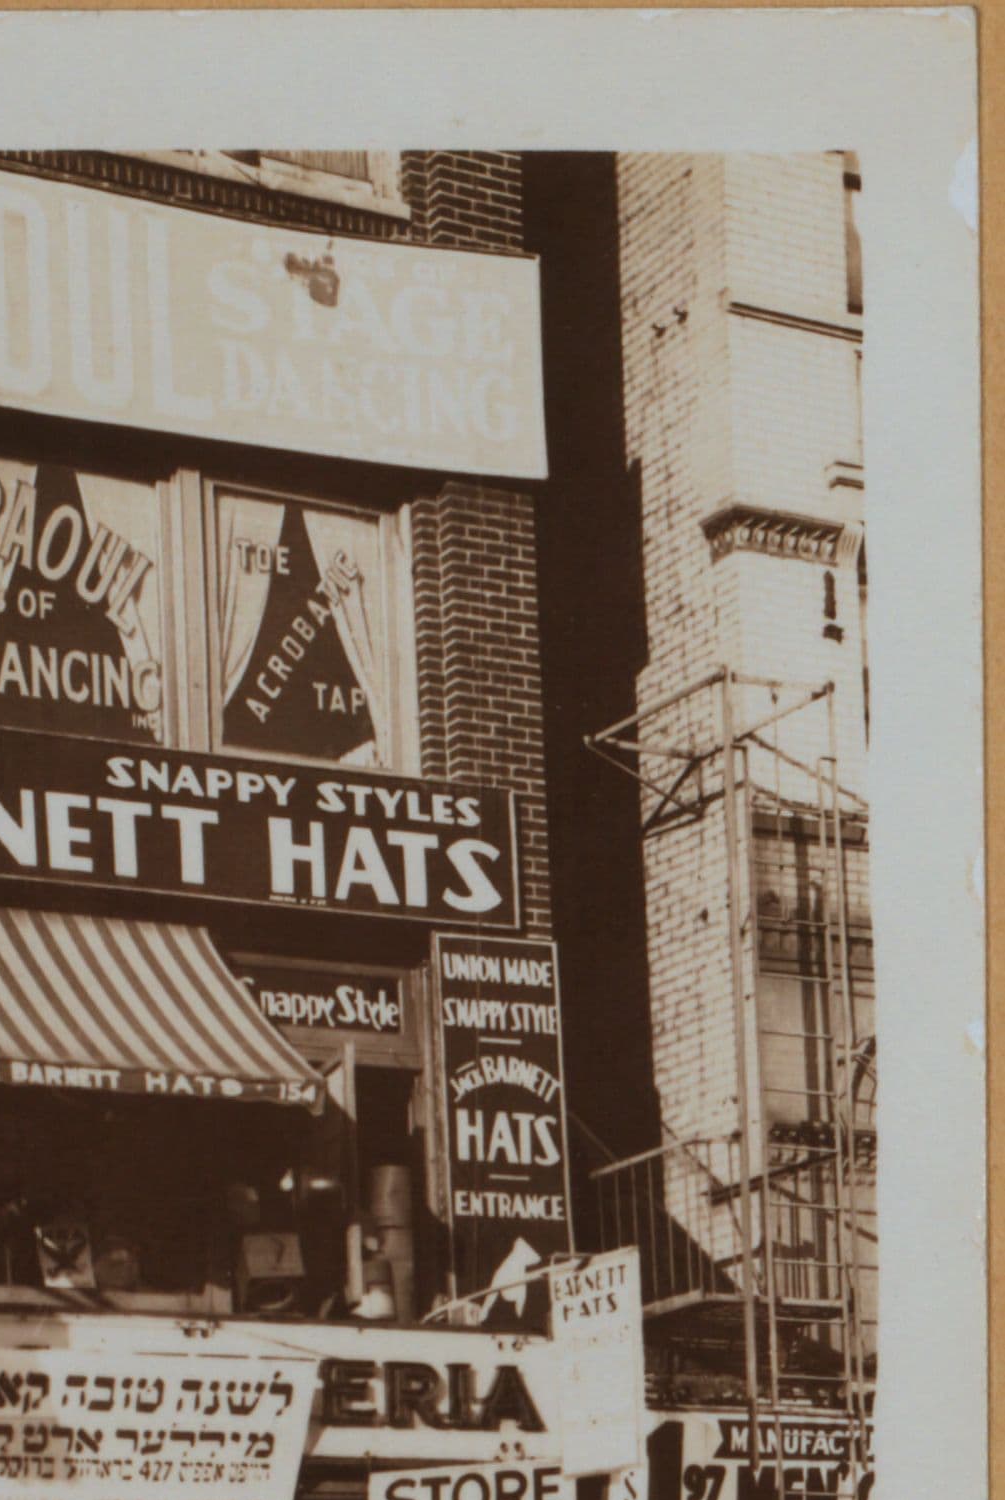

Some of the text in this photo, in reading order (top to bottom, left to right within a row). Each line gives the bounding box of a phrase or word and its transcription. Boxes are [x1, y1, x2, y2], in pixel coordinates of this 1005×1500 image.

[208, 262, 513, 365] STAGE
[224, 340, 518, 442] DANCING
[235, 539, 290, 576] TOE
[18, 588, 56, 620] OF
[246, 550, 363, 723] ACROBATIC
[312, 681, 366, 715] TAP
[107, 756, 482, 827] SNAPPY STYLES
[268, 816, 502, 913] HATS
[443, 952, 553, 988] UNION MADE
[239, 976, 335, 1028] nappy
[443, 997, 557, 1035] SNAPPY STYLE
[12, 1063, 121, 1090] BARNETT
[450, 1055, 562, 1103] JACK BARNETT
[455, 1108, 561, 1167] HATS
[454, 1191, 566, 1221] ENTRANCE
[176, 1371, 294, 1417] לשנה
[139, 1461, 173, 1482] 427
